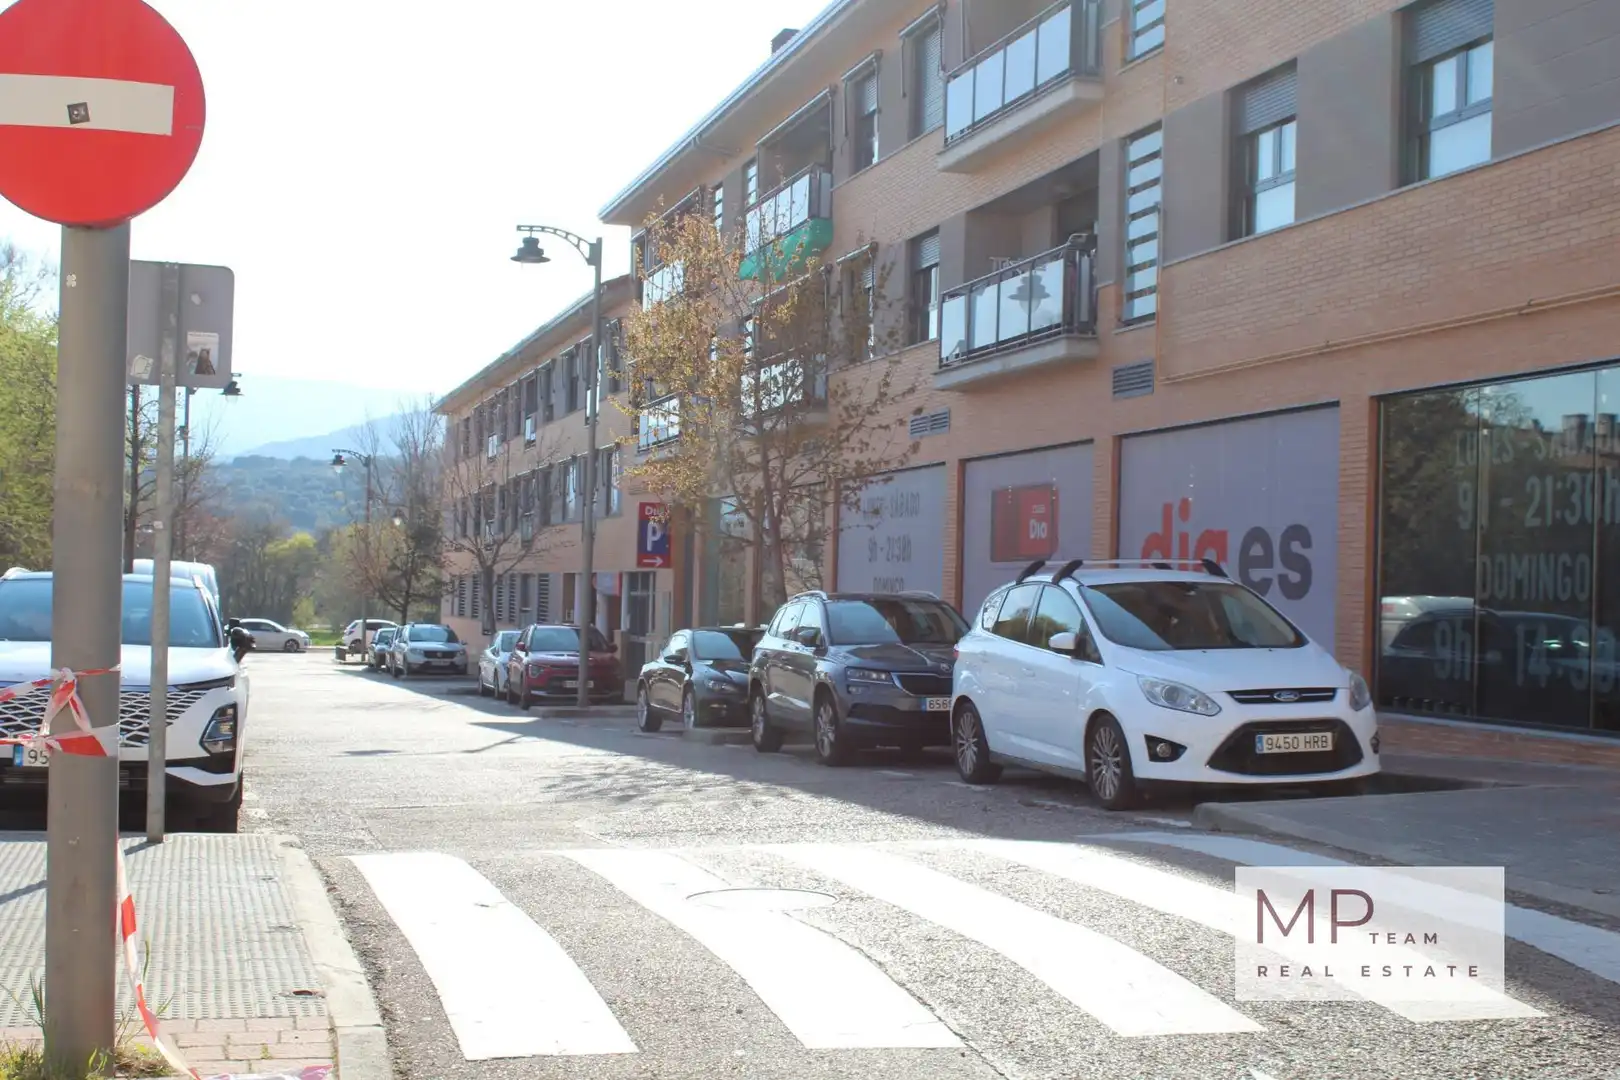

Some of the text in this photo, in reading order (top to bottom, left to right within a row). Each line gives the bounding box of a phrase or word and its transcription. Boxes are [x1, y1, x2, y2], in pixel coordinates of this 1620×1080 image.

[646, 522, 662, 552] P
[1477, 552, 1591, 601] DOMINGO
[1434, 618, 1472, 681] 9h
[1265, 735, 1329, 751] 9450 HRB
